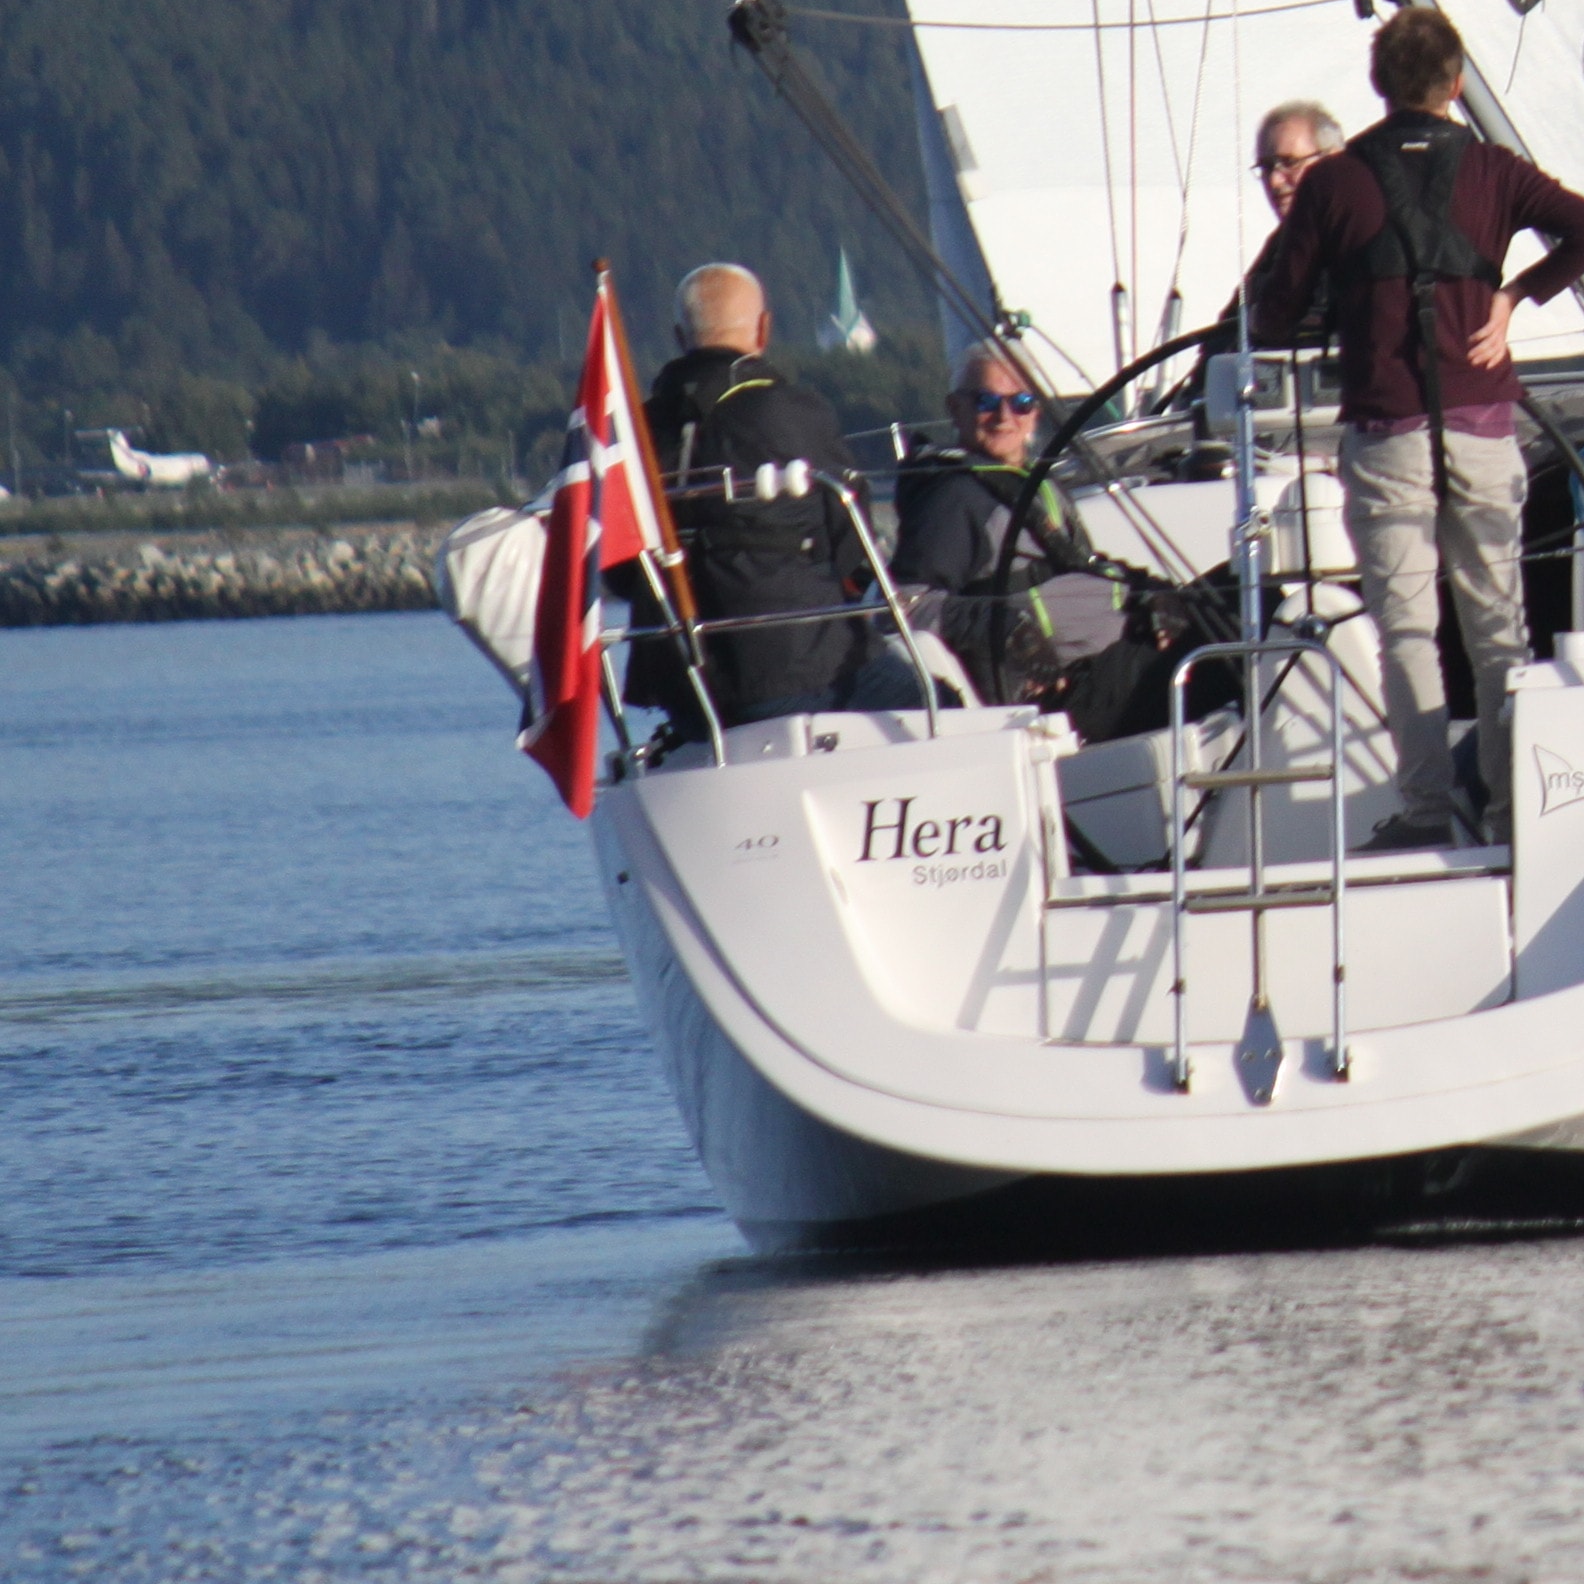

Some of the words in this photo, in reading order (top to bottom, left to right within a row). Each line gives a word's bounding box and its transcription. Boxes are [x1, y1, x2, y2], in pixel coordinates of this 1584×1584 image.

[734, 834, 780, 851] 40
[855, 796, 1008, 864] Hera
[911, 857, 1008, 890] Stjørdal
